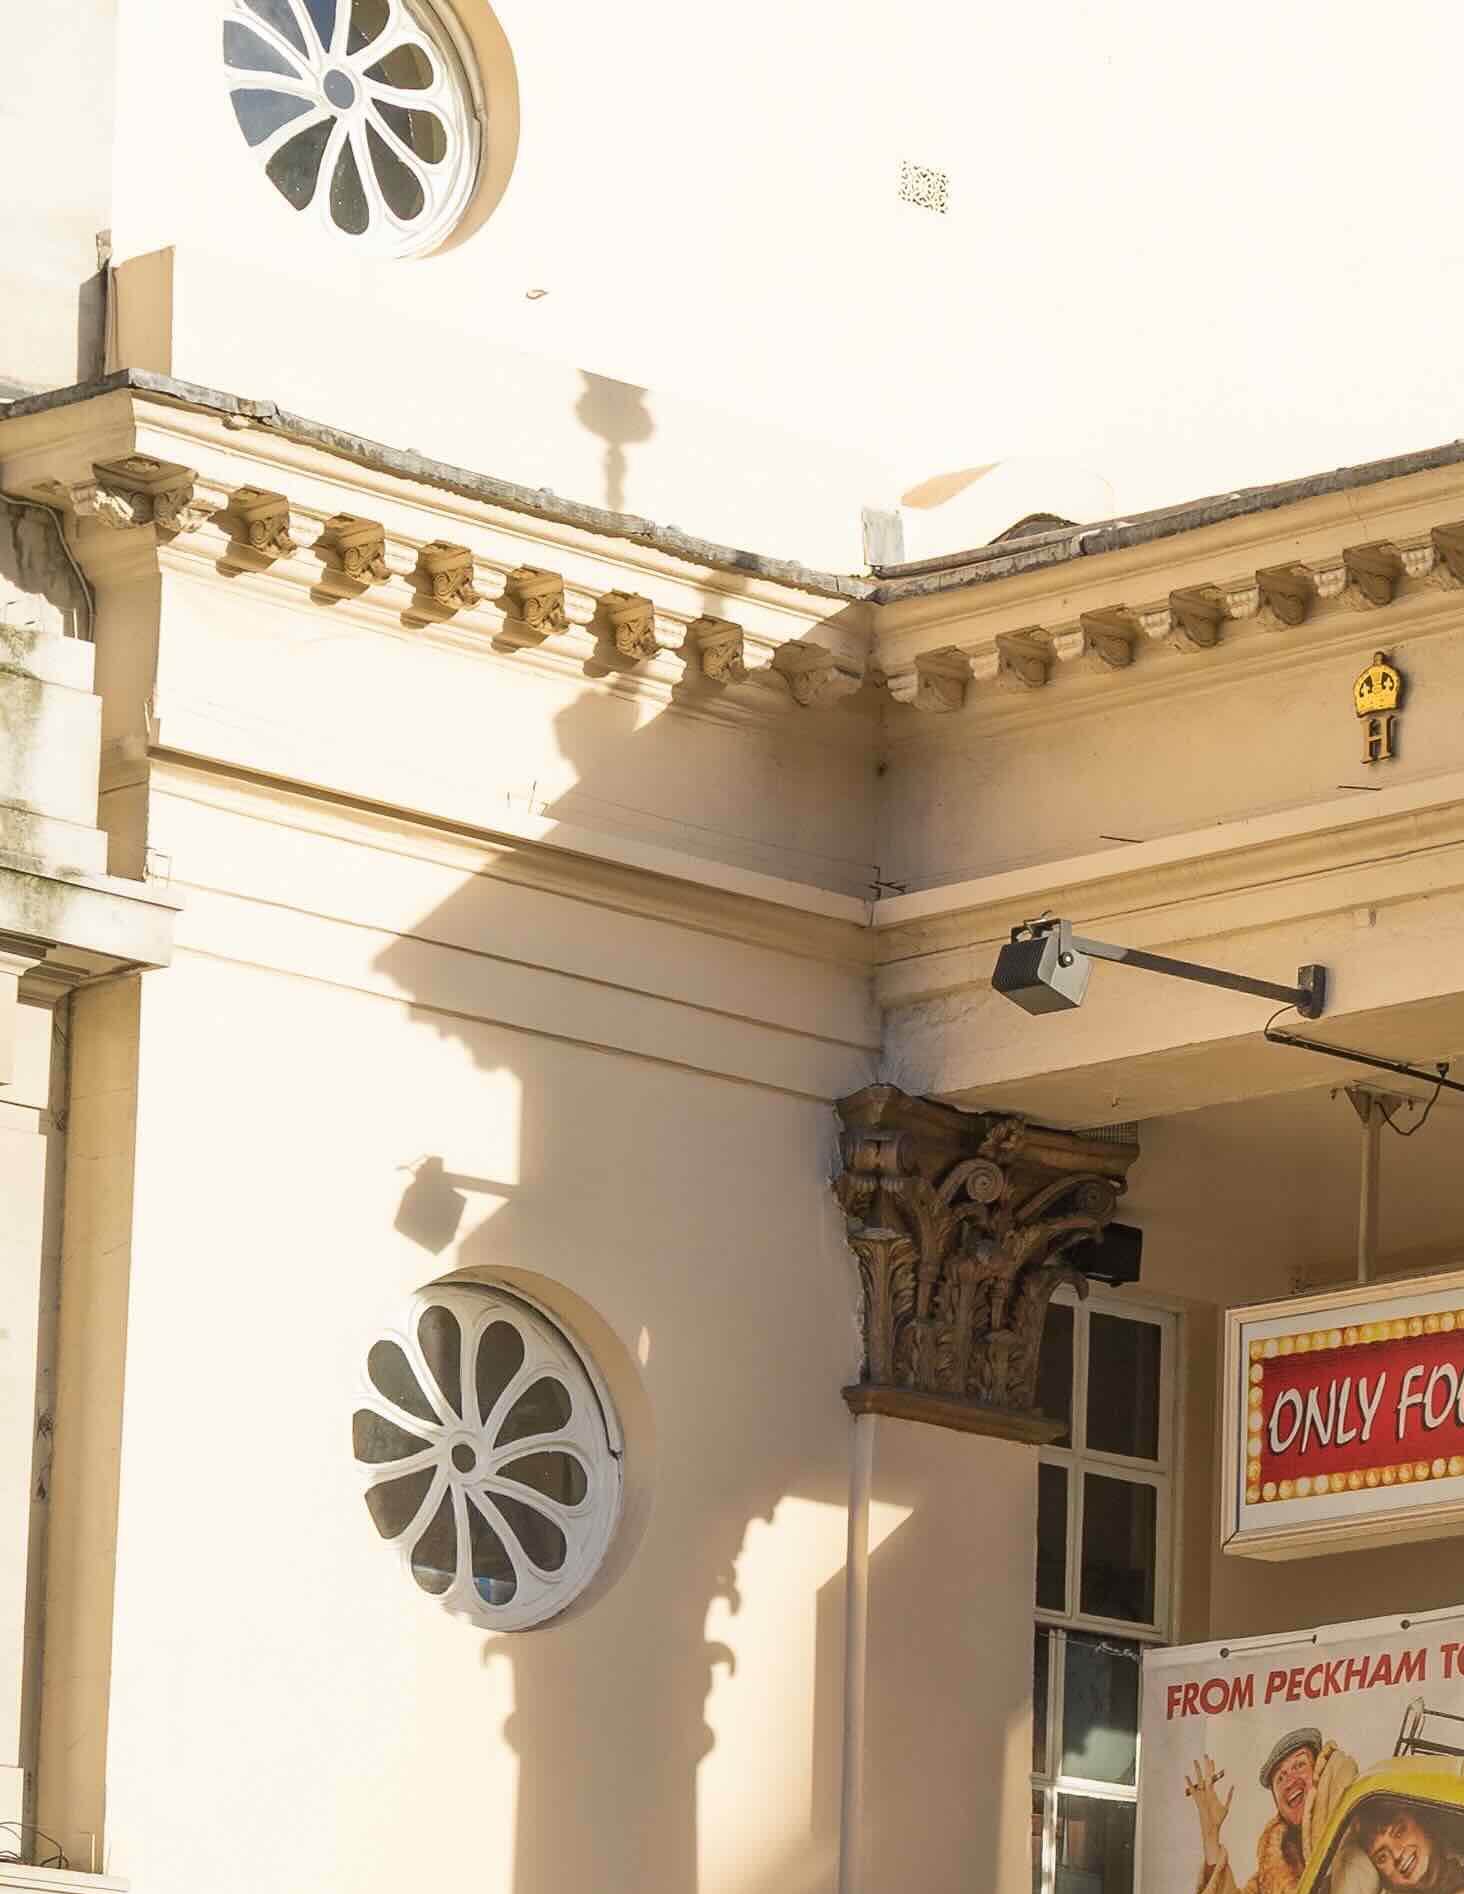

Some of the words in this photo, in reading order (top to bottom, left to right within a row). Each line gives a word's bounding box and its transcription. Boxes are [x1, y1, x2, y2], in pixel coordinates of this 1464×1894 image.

[1268, 1372, 1388, 1456] ONLY
[1166, 1675, 1256, 1721] FROM
[1263, 1650, 1428, 1706] PECKHAM
